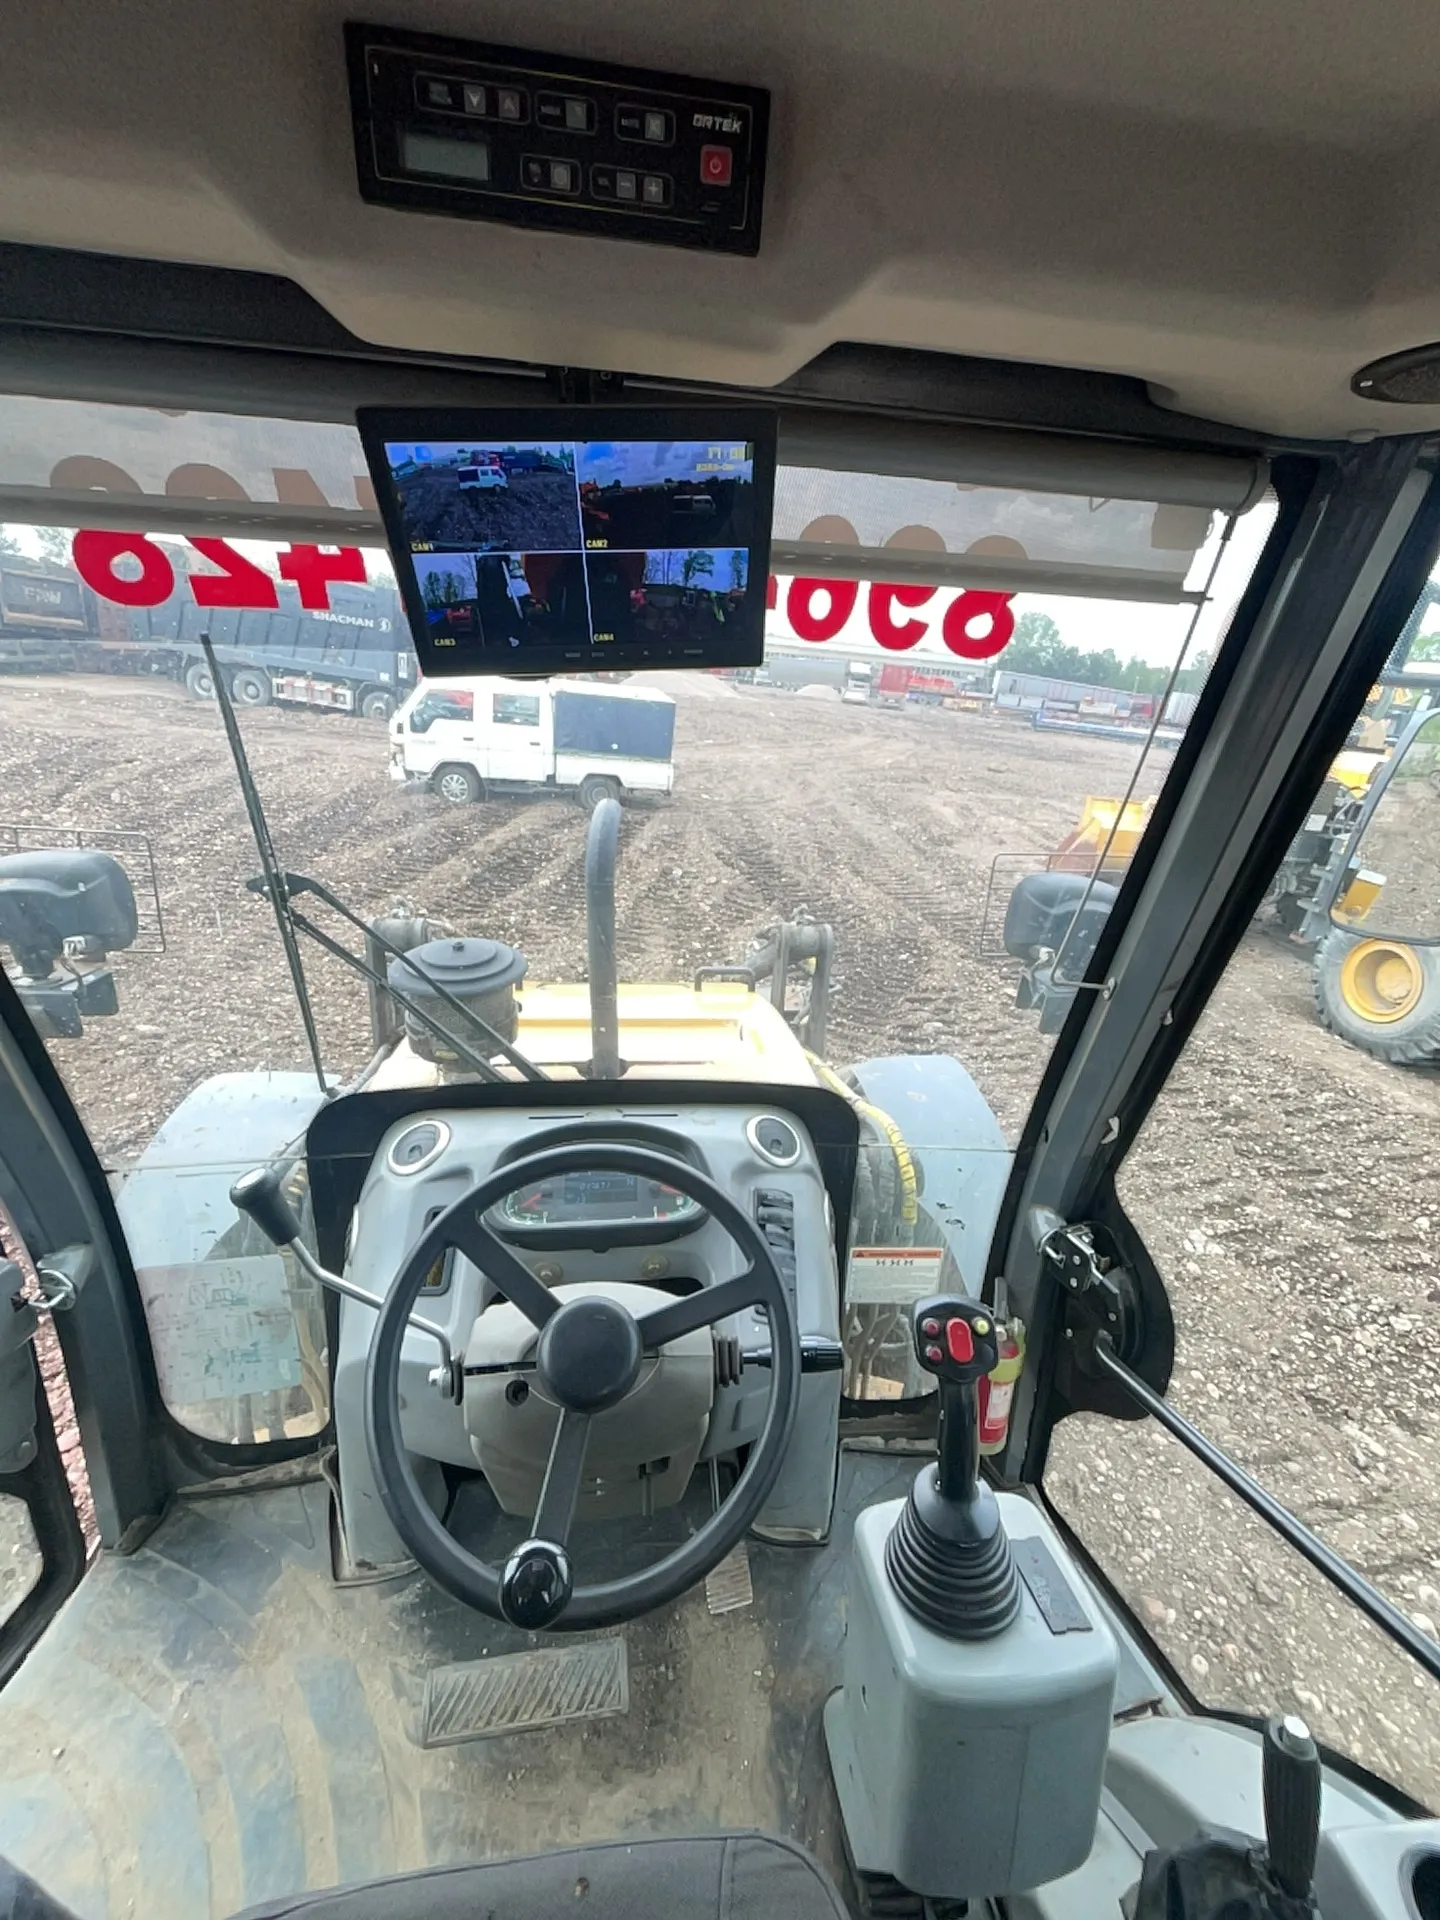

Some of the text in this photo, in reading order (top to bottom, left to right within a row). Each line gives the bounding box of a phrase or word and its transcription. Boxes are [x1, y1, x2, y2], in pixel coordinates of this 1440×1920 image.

[692, 113, 743, 134] ORTEK
[586, 539, 608, 548] CAM2
[312, 611, 375, 629] SHACMAN
[434, 638, 456, 646] CAM3
